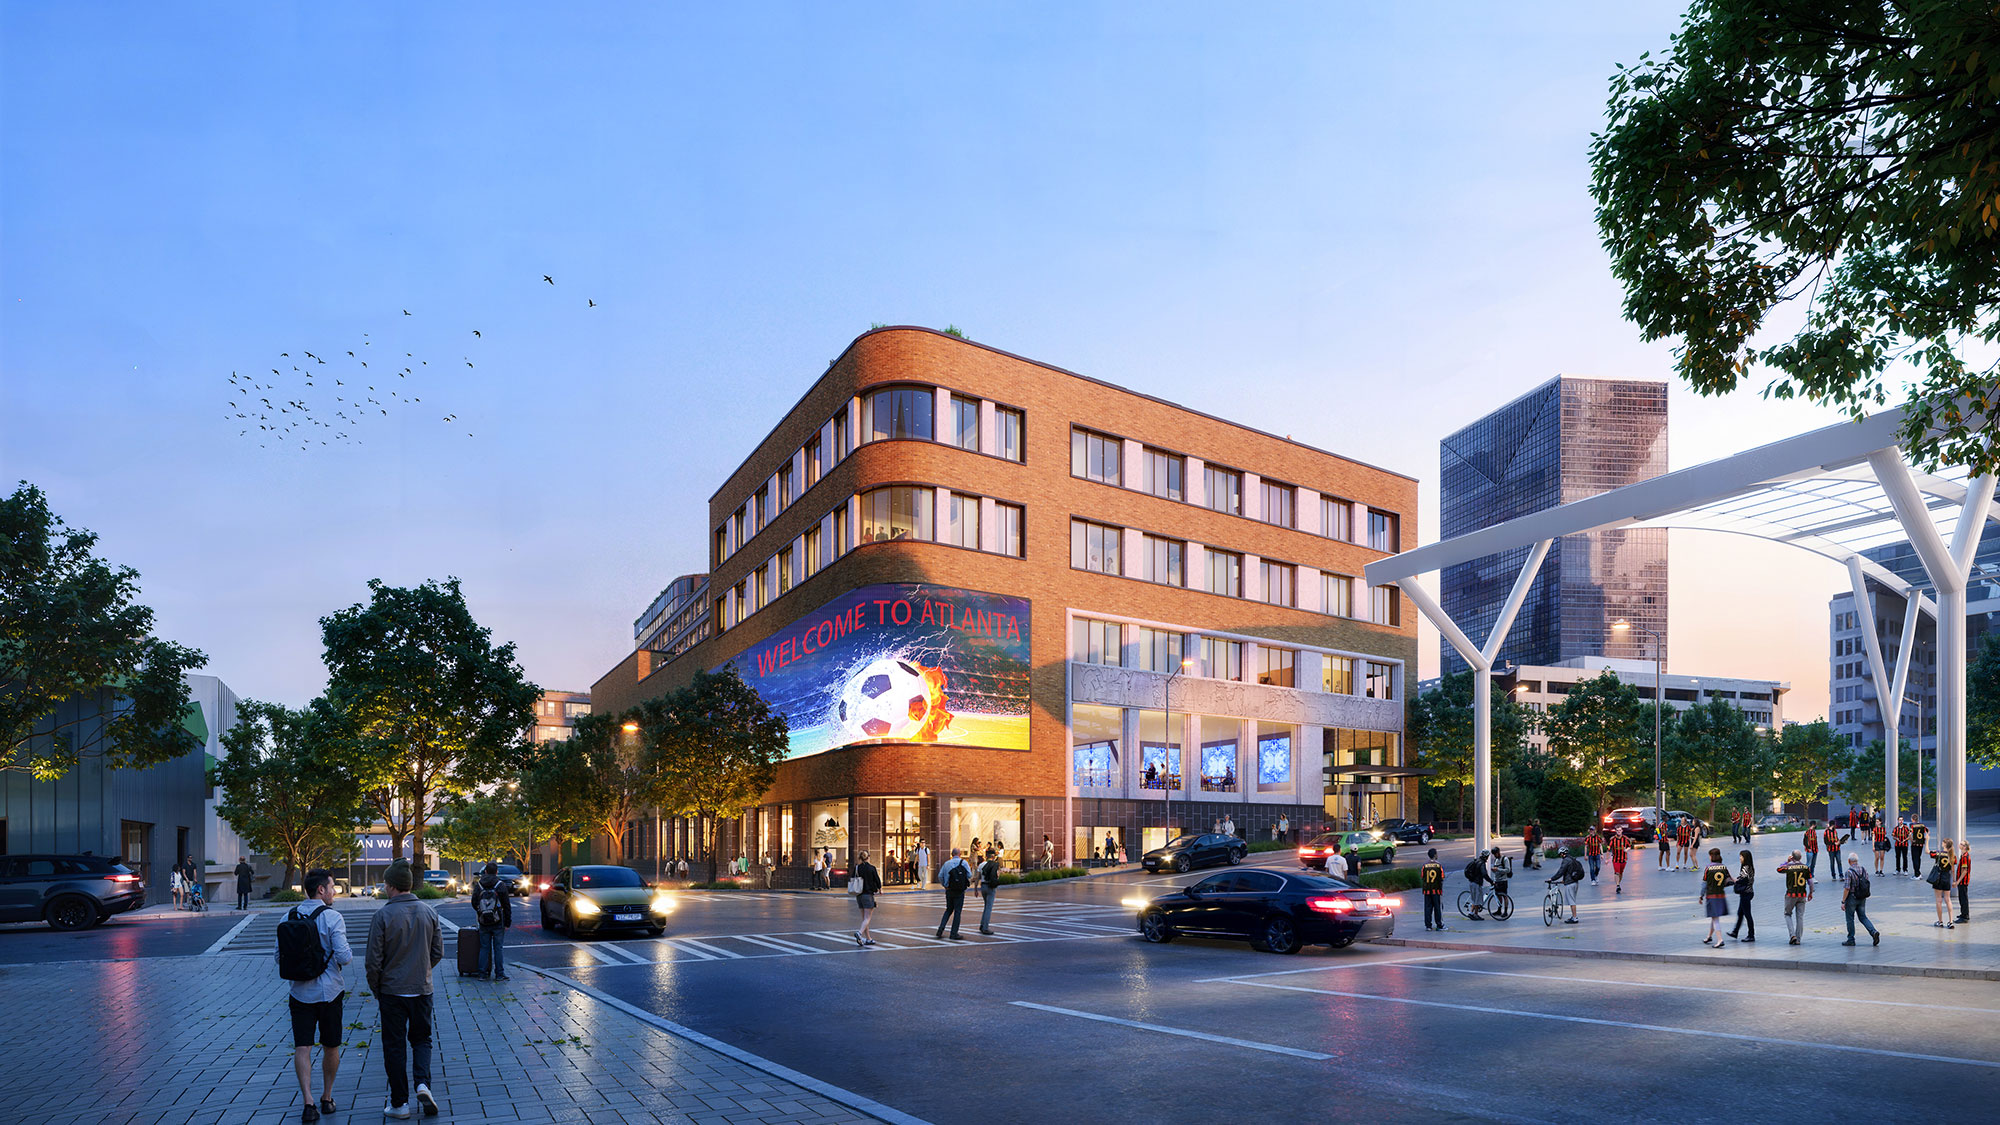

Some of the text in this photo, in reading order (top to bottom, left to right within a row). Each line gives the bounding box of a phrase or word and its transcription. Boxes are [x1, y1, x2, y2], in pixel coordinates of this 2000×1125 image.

[757, 600, 1021, 677] WELCOME TO ATLANTA
[1916, 828, 1923, 839] 6
[354, 839, 410, 849] AN WAK
[1426, 869, 1437, 883] 19
[1714, 871, 1725, 887] 9
[1793, 871, 1806, 887] 16
